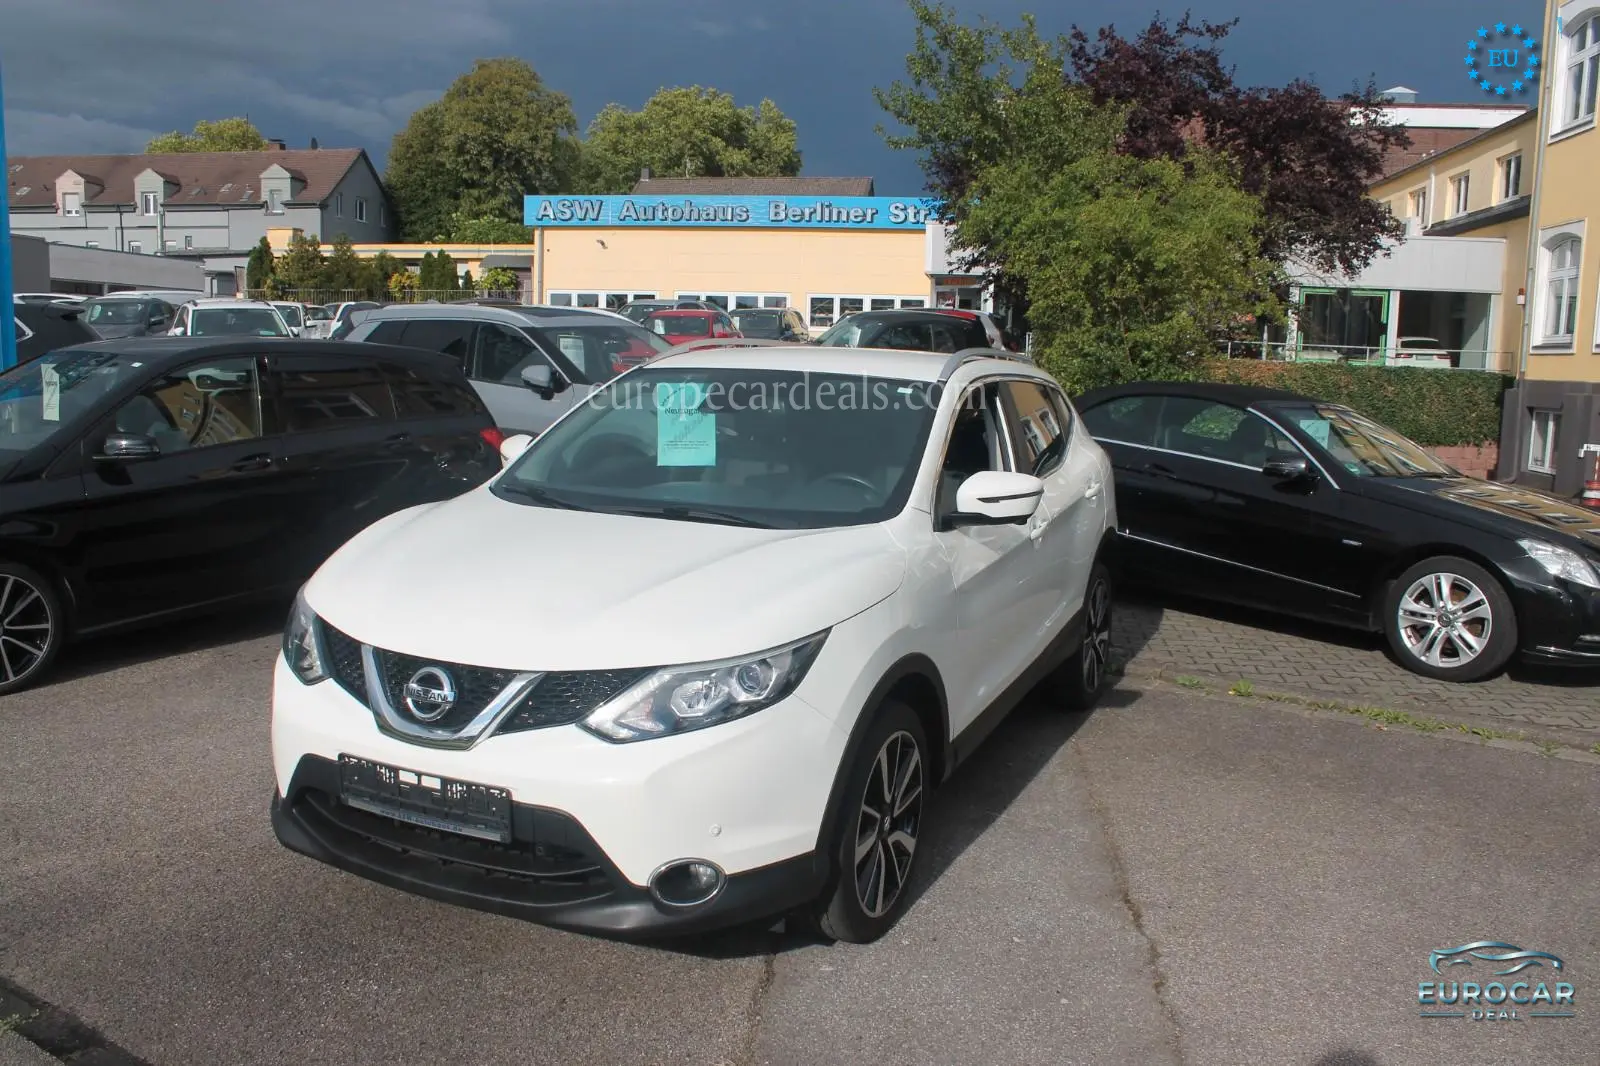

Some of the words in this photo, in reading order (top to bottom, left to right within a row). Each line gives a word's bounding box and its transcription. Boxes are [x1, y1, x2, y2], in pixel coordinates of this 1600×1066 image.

[536, 199, 603, 221] ASW
[618, 200, 749, 222] Autohaus
[769, 201, 878, 223] Berliner
[408, 687, 447, 701] NISSAN
